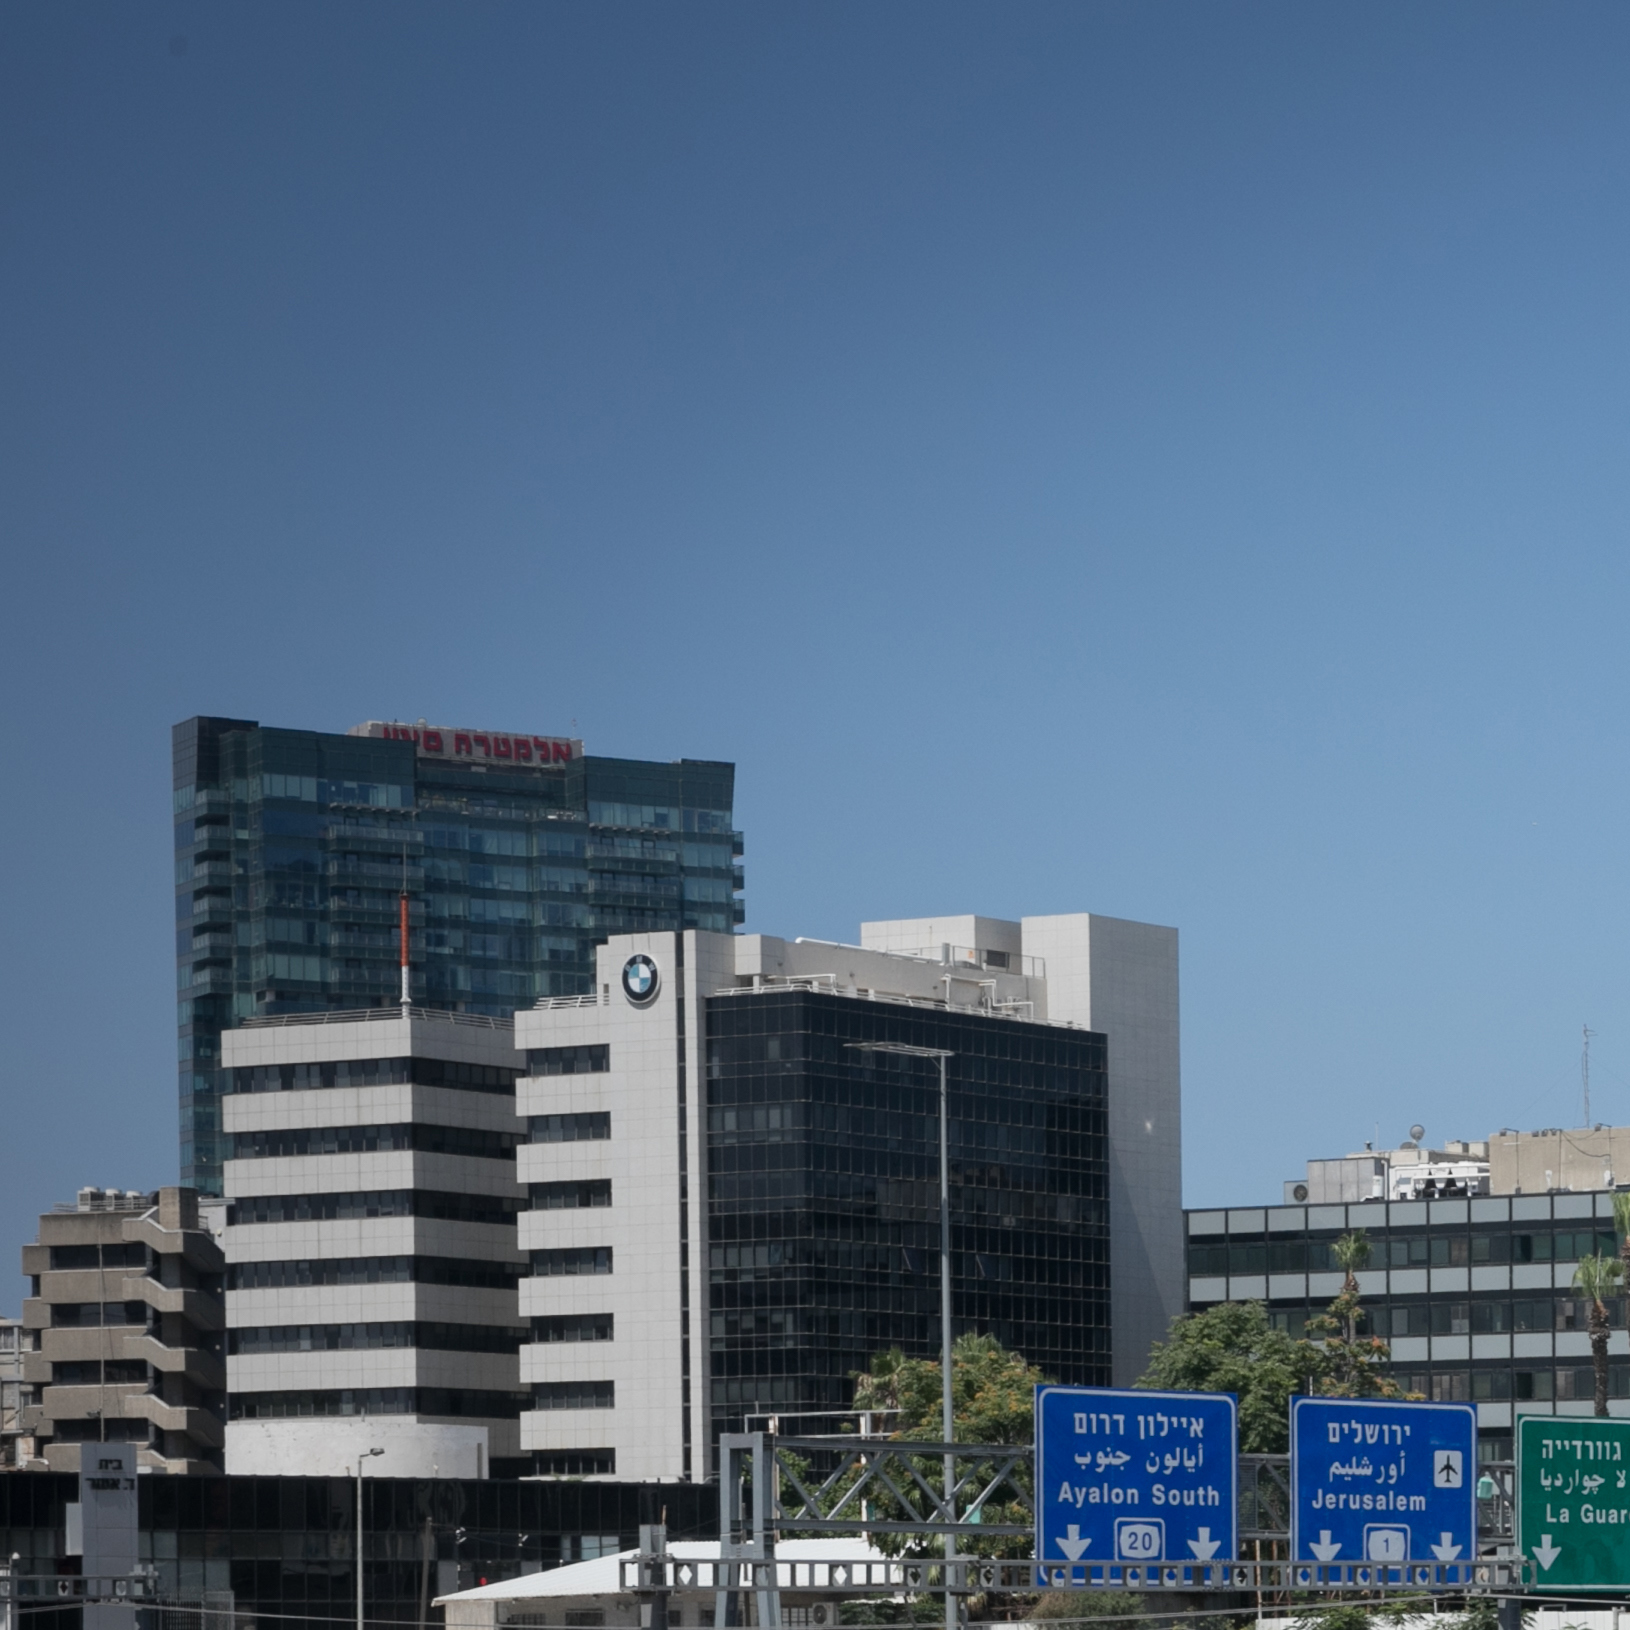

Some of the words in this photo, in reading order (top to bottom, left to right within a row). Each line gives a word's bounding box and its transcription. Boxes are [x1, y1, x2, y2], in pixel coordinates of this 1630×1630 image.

[454, 733, 572, 761] אלקטרה
[1074, 1412, 1125, 1436] דרום
[1137, 1412, 1204, 1440] איילון
[1327, 1420, 1411, 1445] ירושלים
[1074, 1446, 1131, 1473] جنوب
[1146, 1443, 1203, 1475] أيالون
[1542, 1439, 1622, 1461] גוורדייה
[1329, 1450, 1406, 1484] أورشليم
[1616, 1469, 1627, 1489] لا
[1058, 1481, 1139, 1508] Ayalon
[1152, 1483, 1220, 1507] South
[1312, 1488, 1427, 1512] Jerusalem
[1546, 1503, 1570, 1523] La
[1128, 1532, 1152, 1551] 20
[1383, 1537, 1390, 1553] 1
